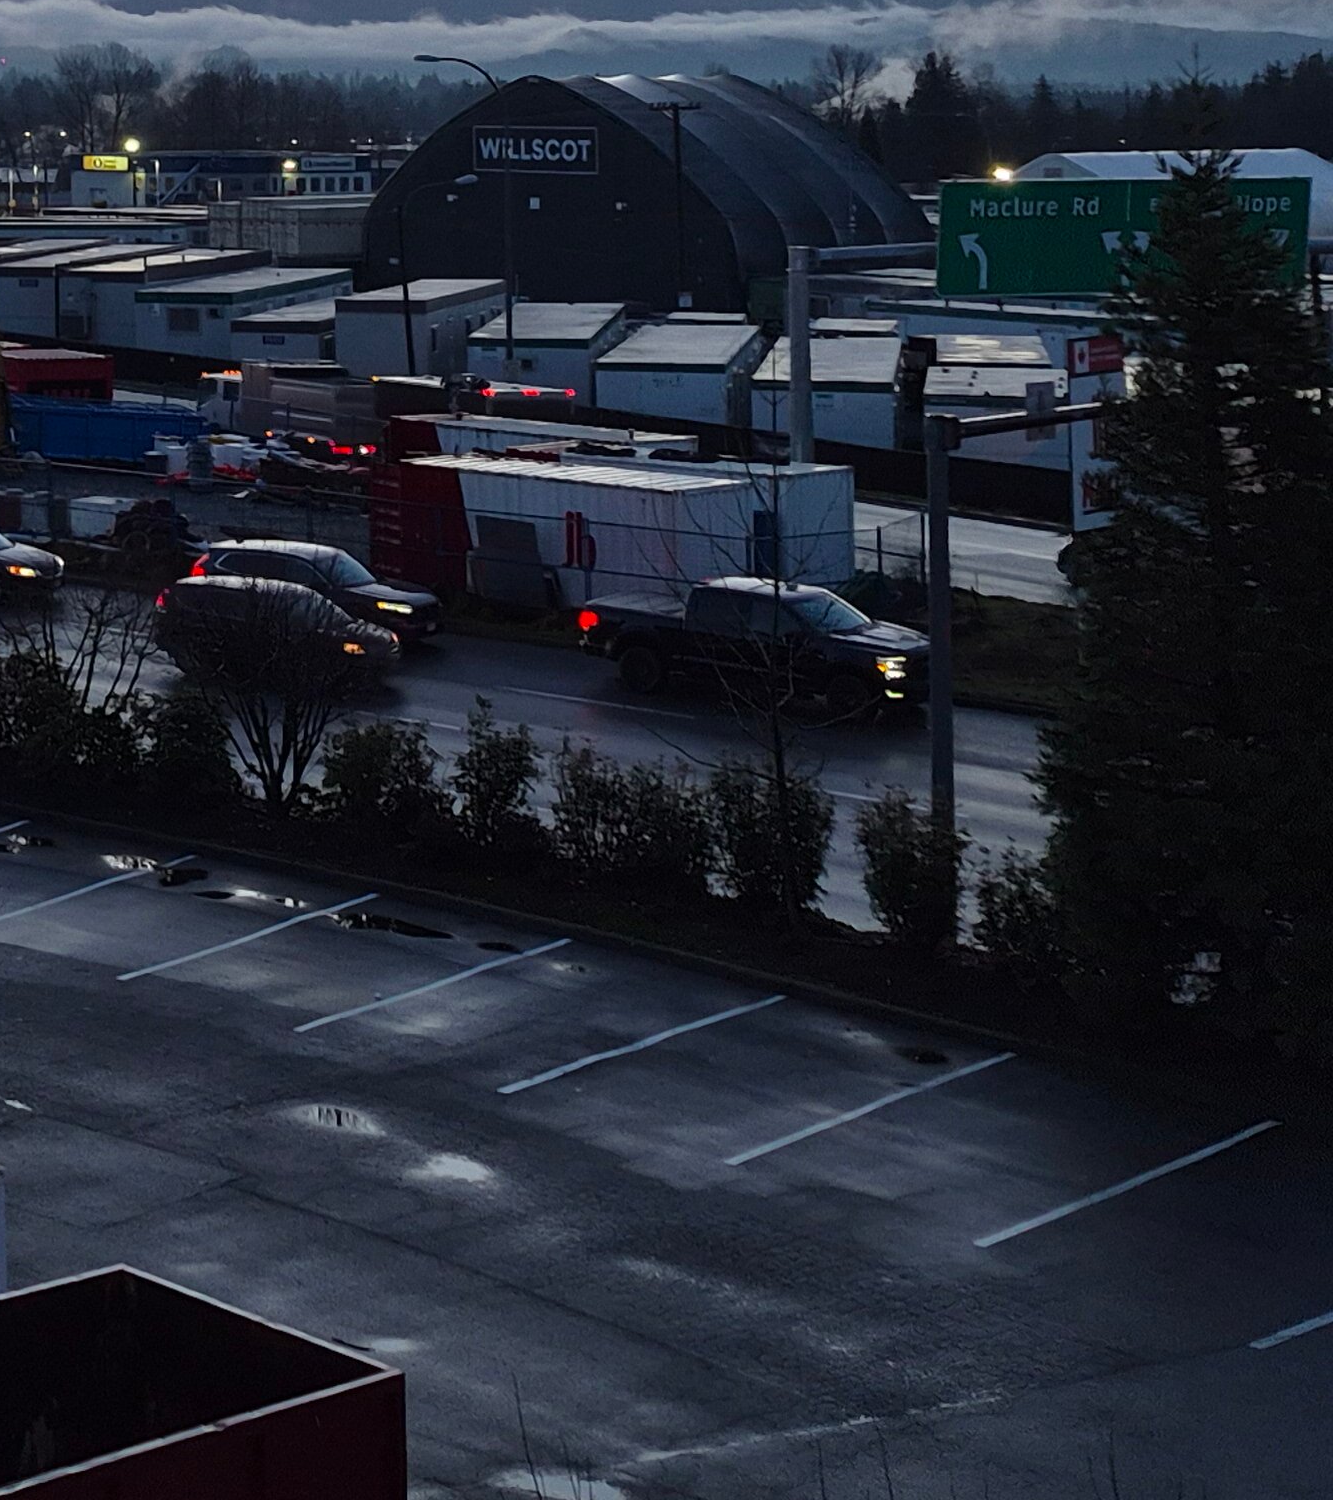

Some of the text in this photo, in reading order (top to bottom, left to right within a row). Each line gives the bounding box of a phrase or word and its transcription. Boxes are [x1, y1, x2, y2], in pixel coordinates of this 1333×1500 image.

[478, 136, 592, 162] WILLSCOT
[969, 195, 1101, 218] Maclure Rd
